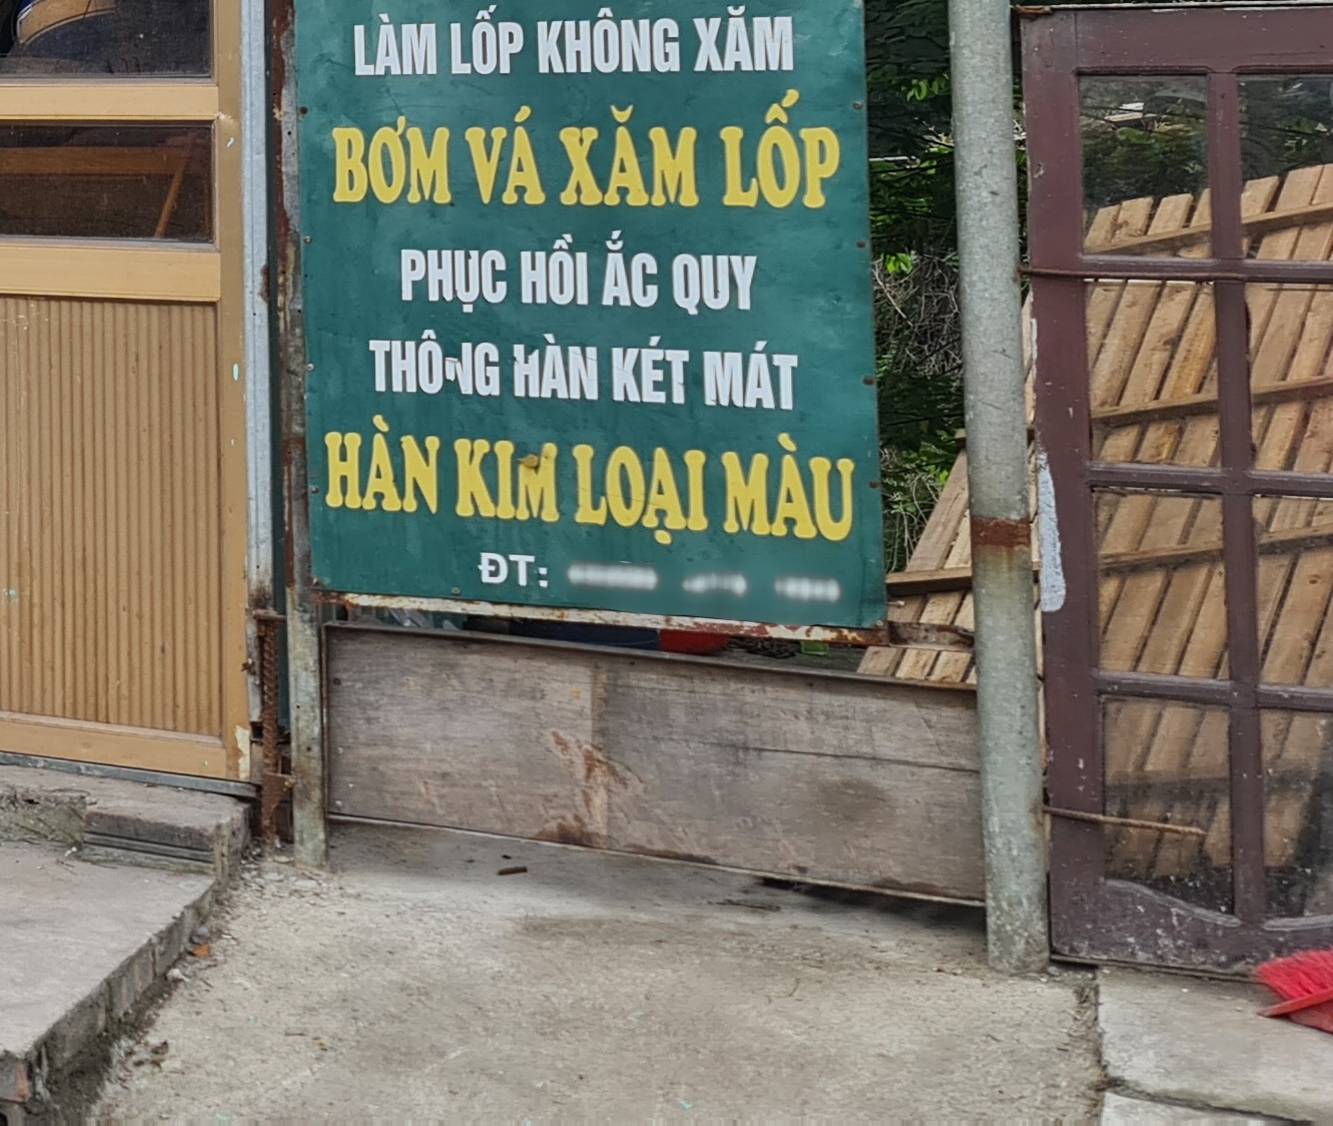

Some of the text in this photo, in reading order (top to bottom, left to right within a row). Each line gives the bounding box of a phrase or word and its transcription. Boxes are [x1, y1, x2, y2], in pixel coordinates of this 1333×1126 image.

[353, 4, 794, 76] LÀM LỐP KHÔNG XĂM
[331, 88, 841, 209] BƠM VÁ XĂM LỐP
[400, 228, 758, 315] PHỤC HỒI ẮC QUY
[513, 332, 599, 401] HÀN
[611, 334, 689, 405] KÉT
[703, 339, 798, 410] MÁT
[324, 413, 856, 546] HÀN KIM LOẠI MÀU
[478, 551, 549, 588] ĐT:
